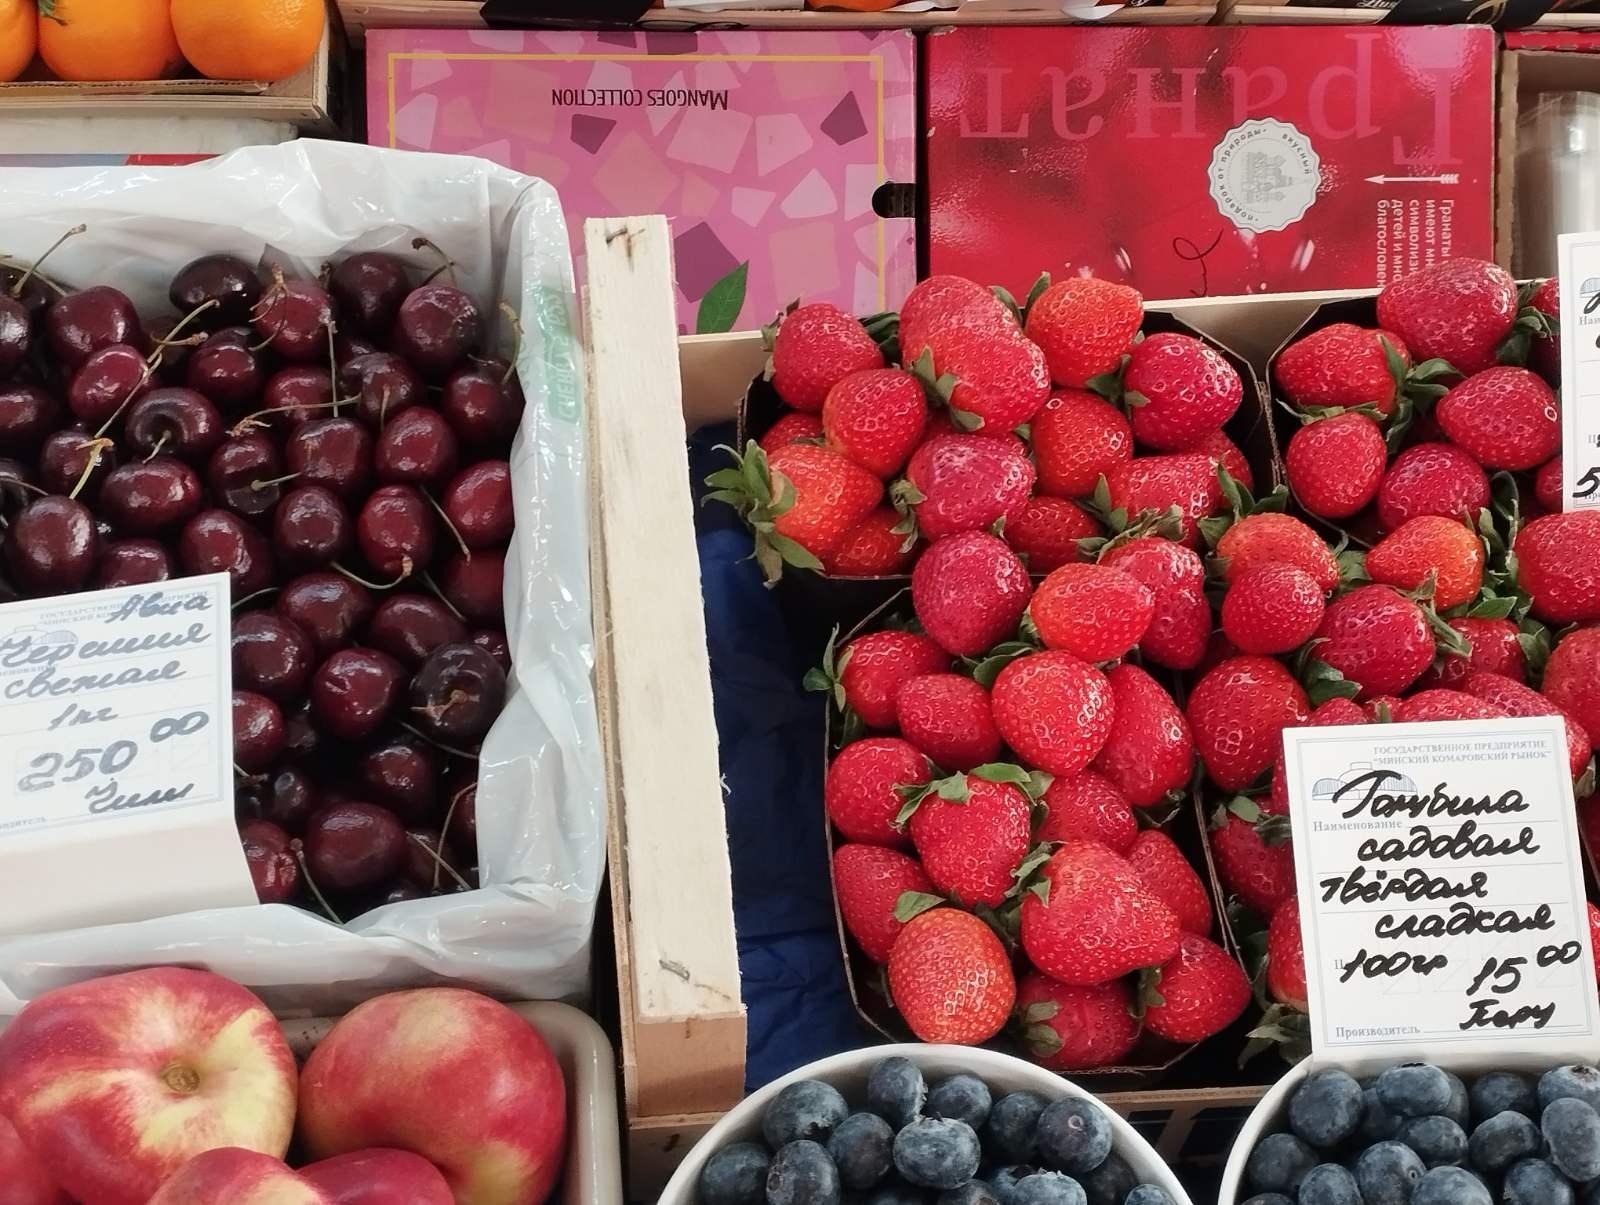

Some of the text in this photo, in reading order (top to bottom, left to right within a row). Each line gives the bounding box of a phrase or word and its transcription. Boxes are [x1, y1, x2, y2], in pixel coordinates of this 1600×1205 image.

[551, 89, 643, 107] COLLECTION
[960, 33, 1462, 166] Гранат
[1281, 133, 1312, 175] вкусный
[1217, 168, 1225, 180] от
[1219, 184, 1255, 221] подарок
[1391, 200, 1406, 240] детей
[1425, 200, 1436, 245] имеют
[1439, 200, 1454, 257] Гранаты
[4, 660, 187, 699] свежая
[17, 710, 210, 792] 250 00
[1373, 740, 1546, 755] ГОСУДАРСТВЕННОЕ ПРЕДПРИЯТИЕ
[1432, 752, 1508, 763] КОМАРОВСКИЙ
[84, 779, 195, 814] Чили
[1313, 819, 1402, 832] Наименование
[1357, 820, 1540, 861] садовая
[1375, 902, 1556, 939] сладкая
[1466, 957, 1527, 996] 15
[1537, 941, 1582, 967] 00
[1336, 1026, 1421, 1038] Производитель
[1459, 999, 1556, 1031] Перу
